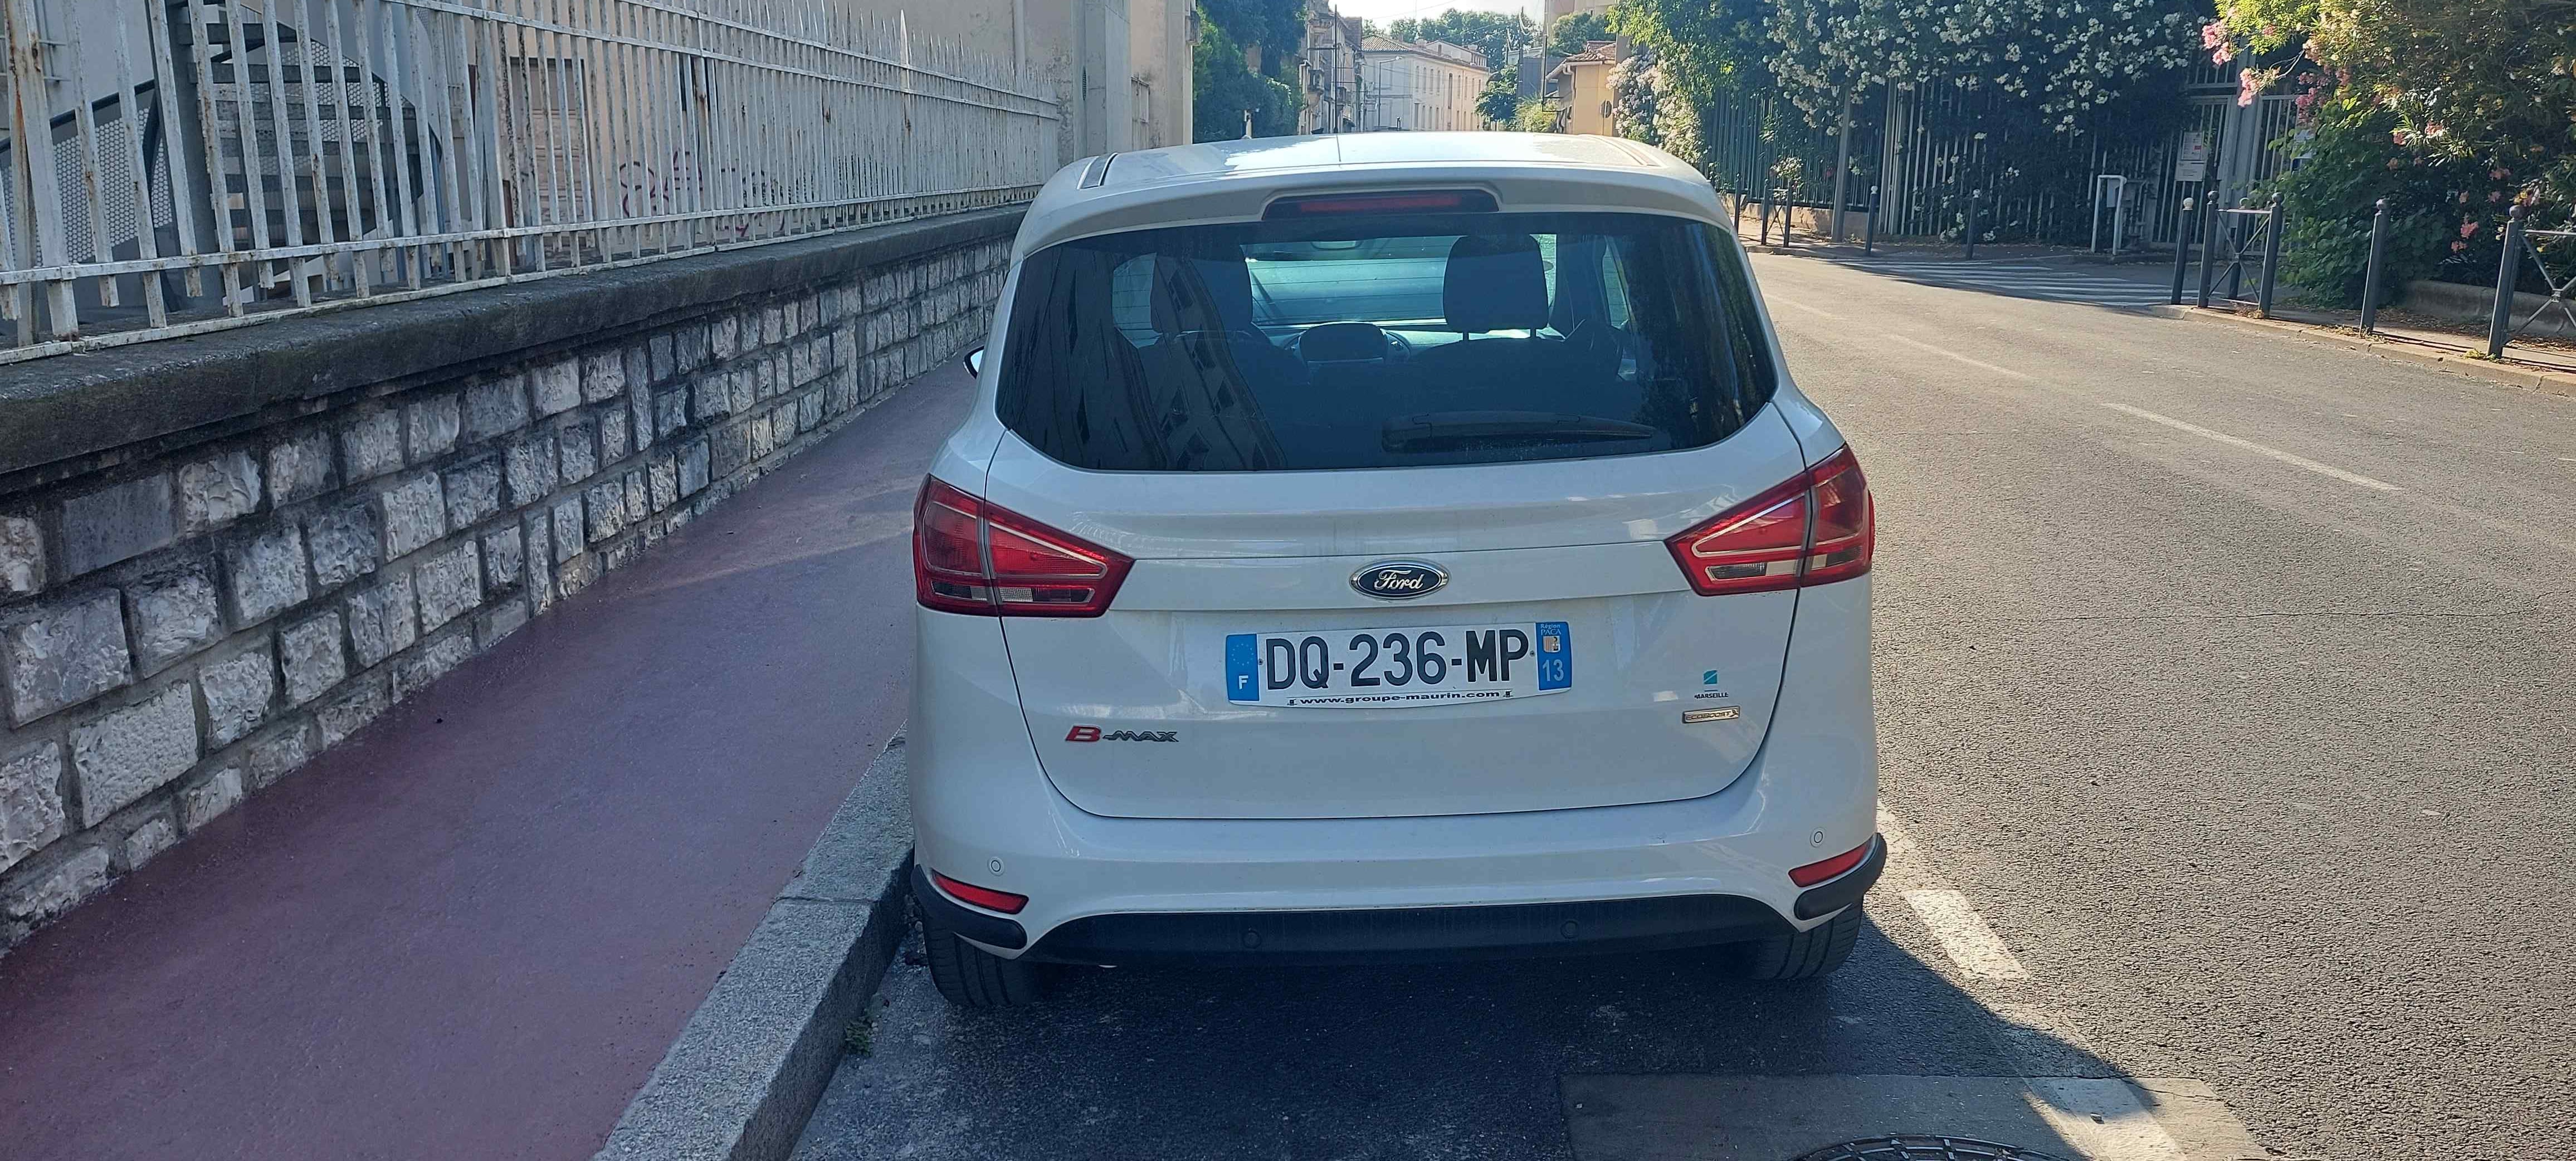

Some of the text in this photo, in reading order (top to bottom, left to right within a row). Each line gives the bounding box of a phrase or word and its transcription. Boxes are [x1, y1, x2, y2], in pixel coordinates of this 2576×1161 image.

[1374, 569, 1424, 590] Ford
[1266, 628, 1529, 690] DQ-236-MP
[1542, 659, 1564, 681] 13
[1238, 675, 1249, 690] F
[1300, 691, 1500, 704] www.groupe-maurin.com
